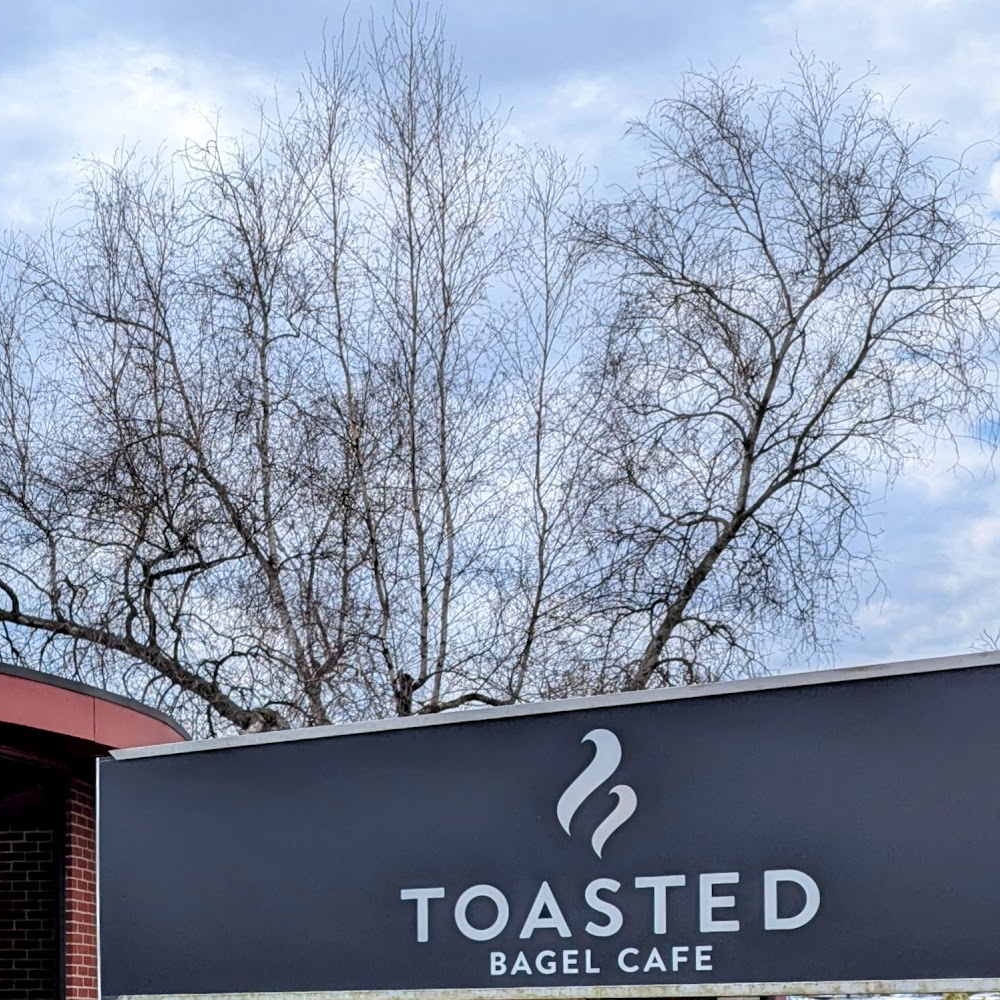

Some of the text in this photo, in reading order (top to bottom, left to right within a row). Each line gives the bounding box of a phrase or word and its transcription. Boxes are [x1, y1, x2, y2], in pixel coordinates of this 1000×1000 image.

[400, 868, 821, 943] TOASTED
[490, 945, 713, 976] BAGEL CAFE
